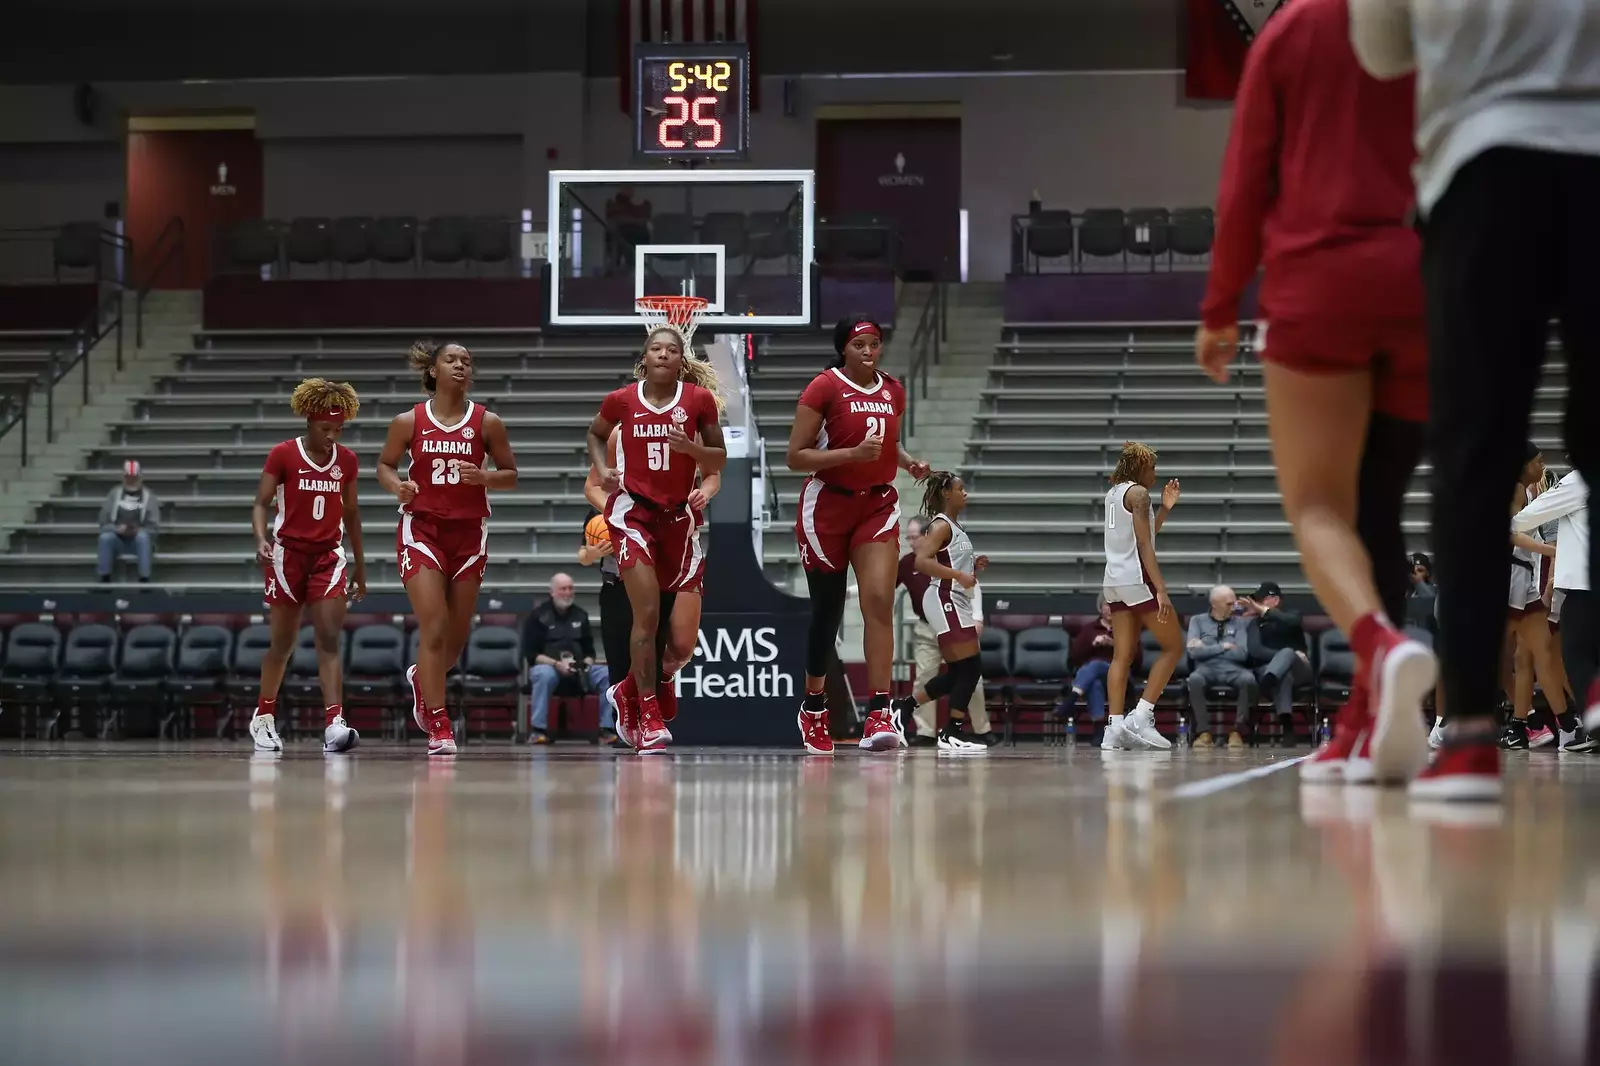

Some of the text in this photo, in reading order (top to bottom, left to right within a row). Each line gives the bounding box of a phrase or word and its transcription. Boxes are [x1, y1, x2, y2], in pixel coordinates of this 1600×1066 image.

[668, 62, 731, 92] 5:42
[659, 96, 721, 148] 25
[210, 185, 237, 196] MEN
[878, 175, 925, 187] WOMEN
[850, 401, 894, 416] ALABAMA
[633, 423, 685, 438] ALABA
[865, 416, 886, 444] 21
[421, 440, 472, 455] ALABAMA
[647, 442, 670, 471] 51
[431, 458, 461, 485] 23
[298, 479, 341, 493] ALABAMA
[312, 494, 326, 521] 0
[674, 664, 795, 698] Health
